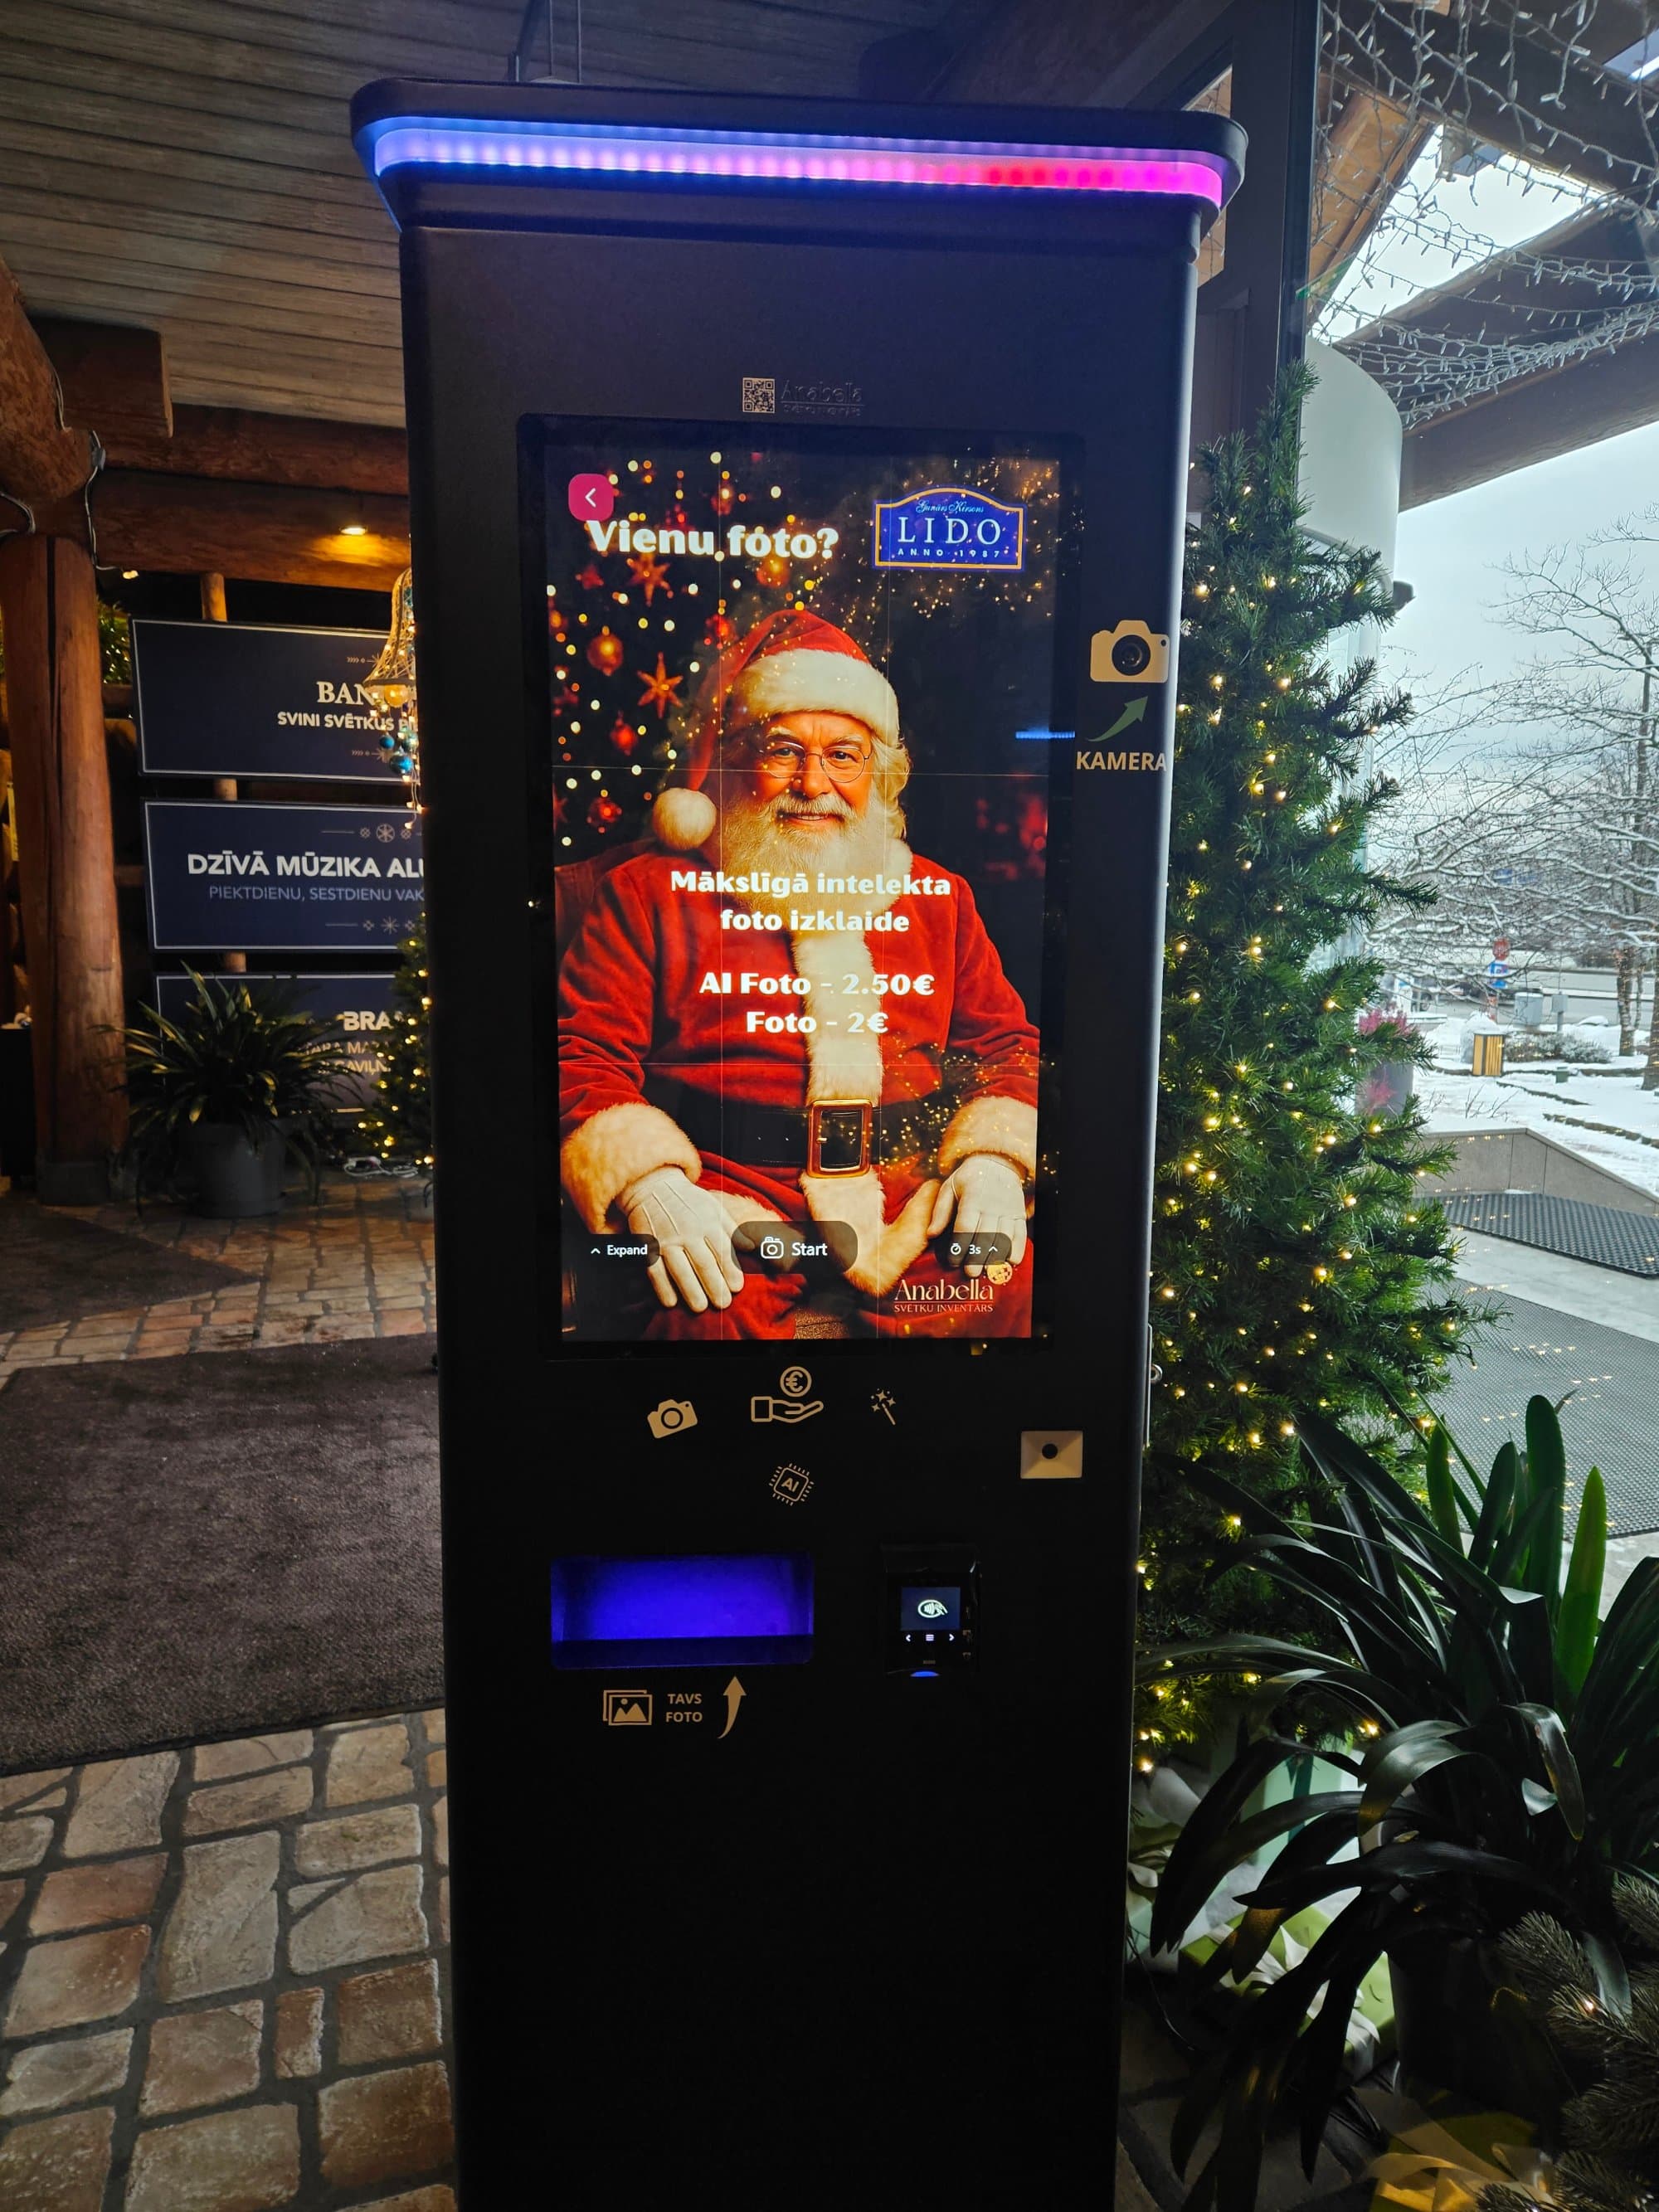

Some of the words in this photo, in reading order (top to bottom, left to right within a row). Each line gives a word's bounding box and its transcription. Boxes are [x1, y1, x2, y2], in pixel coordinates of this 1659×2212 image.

[586, 519, 714, 556] Vienu
[727, 524, 839, 559] foto?
[898, 517, 1001, 545] LIDO
[898, 548, 944, 557] ANNO
[959, 550, 1000, 558] 1987
[277, 712, 320, 727] SVINI
[324, 712, 394, 731] SVĒTKUS
[1076, 751, 1167, 771] KAMERA
[187, 850, 270, 876] DZĪVĀ
[276, 852, 381, 878] MŪZIKA
[670, 870, 809, 898] Mākslīgā
[817, 873, 951, 896] intelekta
[209, 886, 305, 902] PIEKTDIENU,
[309, 887, 392, 902] SESTDIENU
[720, 909, 782, 931] foto
[790, 910, 910, 932] izklaide
[699, 972, 732, 994] AI
[740, 972, 811, 995] Foto
[842, 973, 936, 995] 2.50€
[747, 1011, 817, 1033] Foto
[847, 1012, 889, 1033] 2€
[606, 1244, 648, 1257] Expand
[791, 1242, 828, 1257] Start
[968, 1245, 982, 1255] 3s
[894, 1278, 994, 1301] Anabella
[894, 1301, 934, 1313] SVĒTKU
[937, 1302, 994, 1313] INVENTĀRS
[781, 1477, 800, 1492] AI
[666, 1693, 703, 1705] TAVS
[665, 1711, 703, 1723] FOTO
